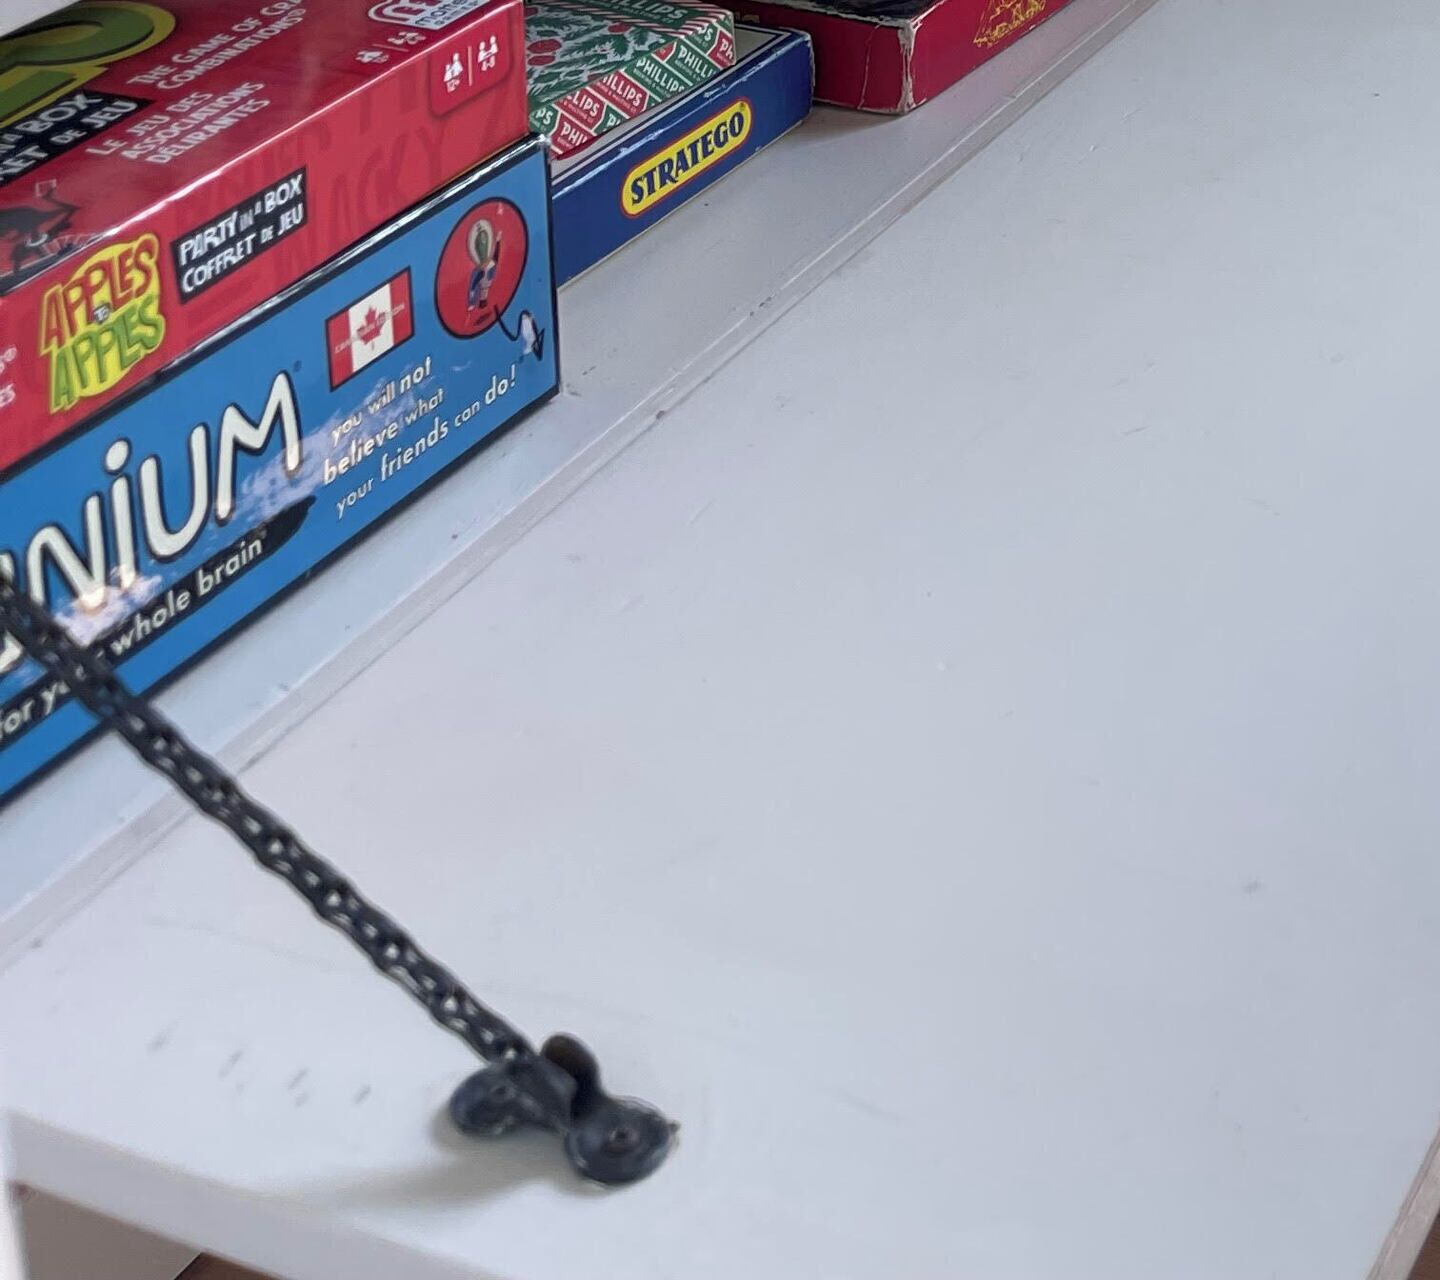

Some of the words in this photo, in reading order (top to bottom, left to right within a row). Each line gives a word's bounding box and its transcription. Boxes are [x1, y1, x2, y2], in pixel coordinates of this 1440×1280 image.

[127, 64, 174, 85] THE
[171, 31, 236, 65] GAME
[231, 16, 263, 34] OF
[15, 92, 103, 135] BOX
[50, 129, 87, 147] DE
[86, 99, 139, 132] JEU
[86, 138, 127, 157] LE
[126, 114, 171, 137] JEU
[165, 90, 214, 113] DES
[120, 80, 267, 161] ASSOCIATIONS
[144, 97, 272, 166] DÉLIRANTES
[630, 111, 745, 206] STRATEGO
[179, 209, 238, 266] PARTY
[264, 174, 304, 213] BOX
[181, 232, 257, 292] COFFRET
[260, 226, 274, 244] DE
[277, 204, 304, 237] JEU
[40, 233, 160, 356] APPLES
[50, 295, 166, 415] APPLES
[323, 423, 398, 485] believe
[403, 388, 444, 426] what
[330, 411, 363, 447] you
[367, 381, 395, 415] will
[399, 355, 433, 395] not
[336, 477, 375, 520] your
[380, 416, 449, 482] friends
[454, 401, 481, 429] can
[484, 363, 517, 406] do!
[111, 590, 191, 658] whole
